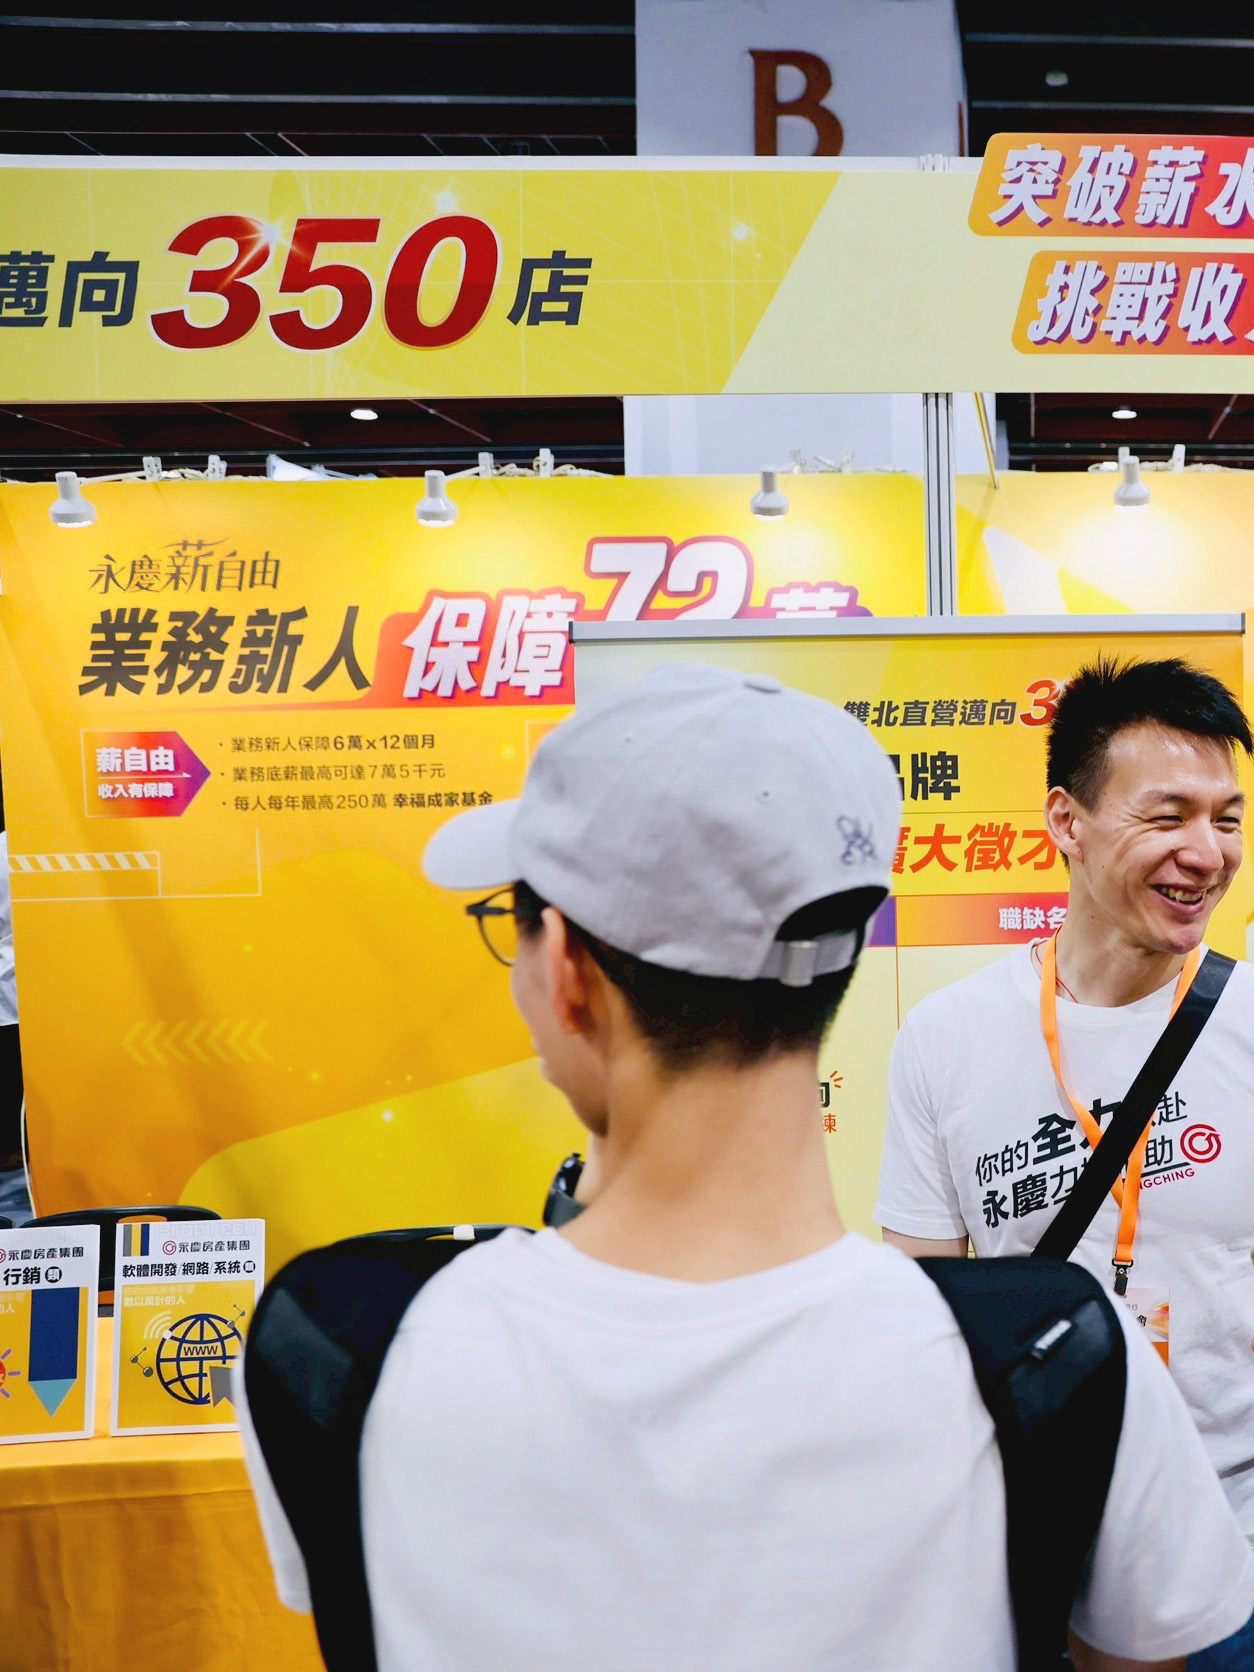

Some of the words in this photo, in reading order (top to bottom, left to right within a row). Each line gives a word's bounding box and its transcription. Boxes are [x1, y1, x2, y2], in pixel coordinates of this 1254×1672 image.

[748, 48, 844, 157] B
[78, 605, 373, 697] 業務新人
[401, 542, 848, 700] 保障72
[844, 678, 1072, 729] 雙北直營邁向3
[96, 746, 175, 772] 薪自由
[232, 763, 446, 782] 業務底薪最高可達7萬5千元
[97, 782, 175, 799] 收入有保障
[234, 794, 387, 812] 每人每年最高250萬
[975, 1092, 1188, 1186] 你的全力赴
[982, 1135, 1174, 1229] 永慶力助
[1139, 1167, 1195, 1190] GCHING
[8, 1246, 84, 1261] 永慶房產集團
[179, 1240, 250, 1253] 永慶房產集團
[3, 1266, 41, 1286] 行銷
